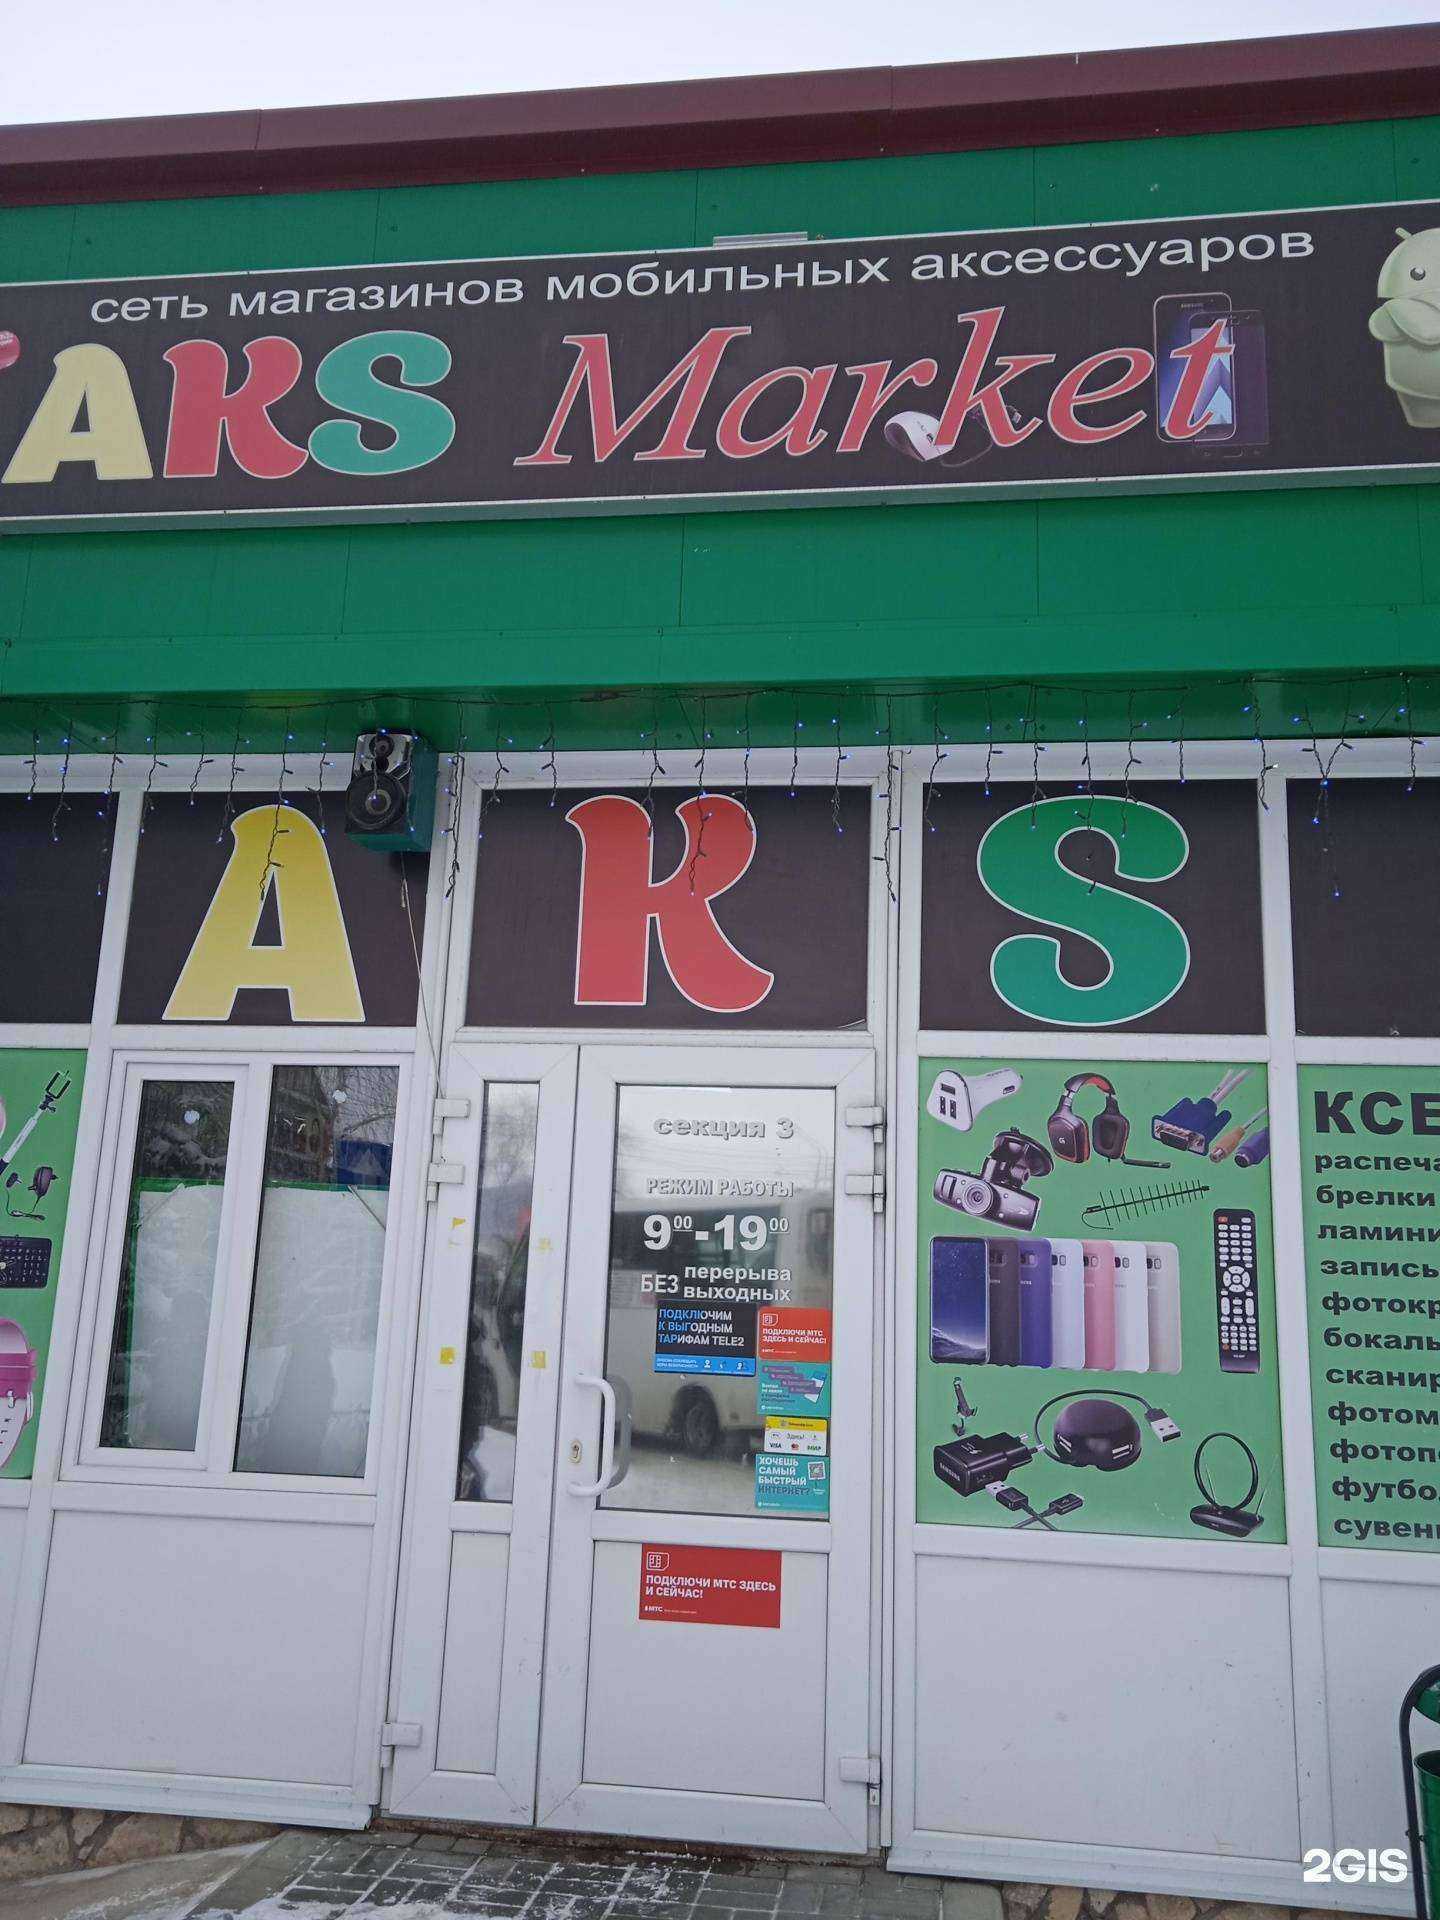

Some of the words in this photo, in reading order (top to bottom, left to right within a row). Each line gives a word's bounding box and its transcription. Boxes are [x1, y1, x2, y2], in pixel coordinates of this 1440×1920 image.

[91, 294, 208, 322] сеть
[229, 277, 523, 317] магазинов
[547, 256, 889, 301] мобильных
[911, 232, 1315, 280] аксессуаров
[513, 306, 1236, 466] Market
[653, 1118, 766, 1140] секция
[775, 1117, 794, 1139] 3
[647, 1178, 713, 1196] РЕЖИМ
[718, 1179, 794, 1198] РАБОТЫ
[1316, 1185, 1436, 1209] брелки
[1320, 1259, 1440, 1278] запись
[641, 1273, 679, 1294] БЕЗ
[684, 1266, 791, 1284] перерыва
[684, 1286, 791, 1302] выходных
[659, 1308, 732, 1321] ПОДКЛЮЧИМ
[658, 1321, 666, 1331] К
[668, 1321, 733, 1334] ВЫГОДНЫМ
[762, 1328, 805, 1336] ПОДКЛЮЧИ
[658, 1333, 710, 1345] ТАРИФАМ
[711, 1335, 745, 1347] TELE2
[1330, 1438, 1440, 1463] фотоп
[758, 1456, 798, 1467] ХОЧЕШЬ
[758, 1466, 796, 1476] САМЫЙ
[758, 1476, 807, 1486] БЫСТРЫЙ
[1332, 1475, 1440, 1503] футбо
[758, 1485, 810, 1496] ИНТЕРНЕТ?
[1334, 1518, 1440, 1541] сувен
[646, 1574, 711, 1588] ПОДКЛЮЧИ
[713, 1579, 737, 1589] МТС
[739, 1581, 776, 1592] ЗДЕСЬ
[645, 1586, 653, 1596] И
[656, 1586, 704, 1599] СЕЙЧАС!
